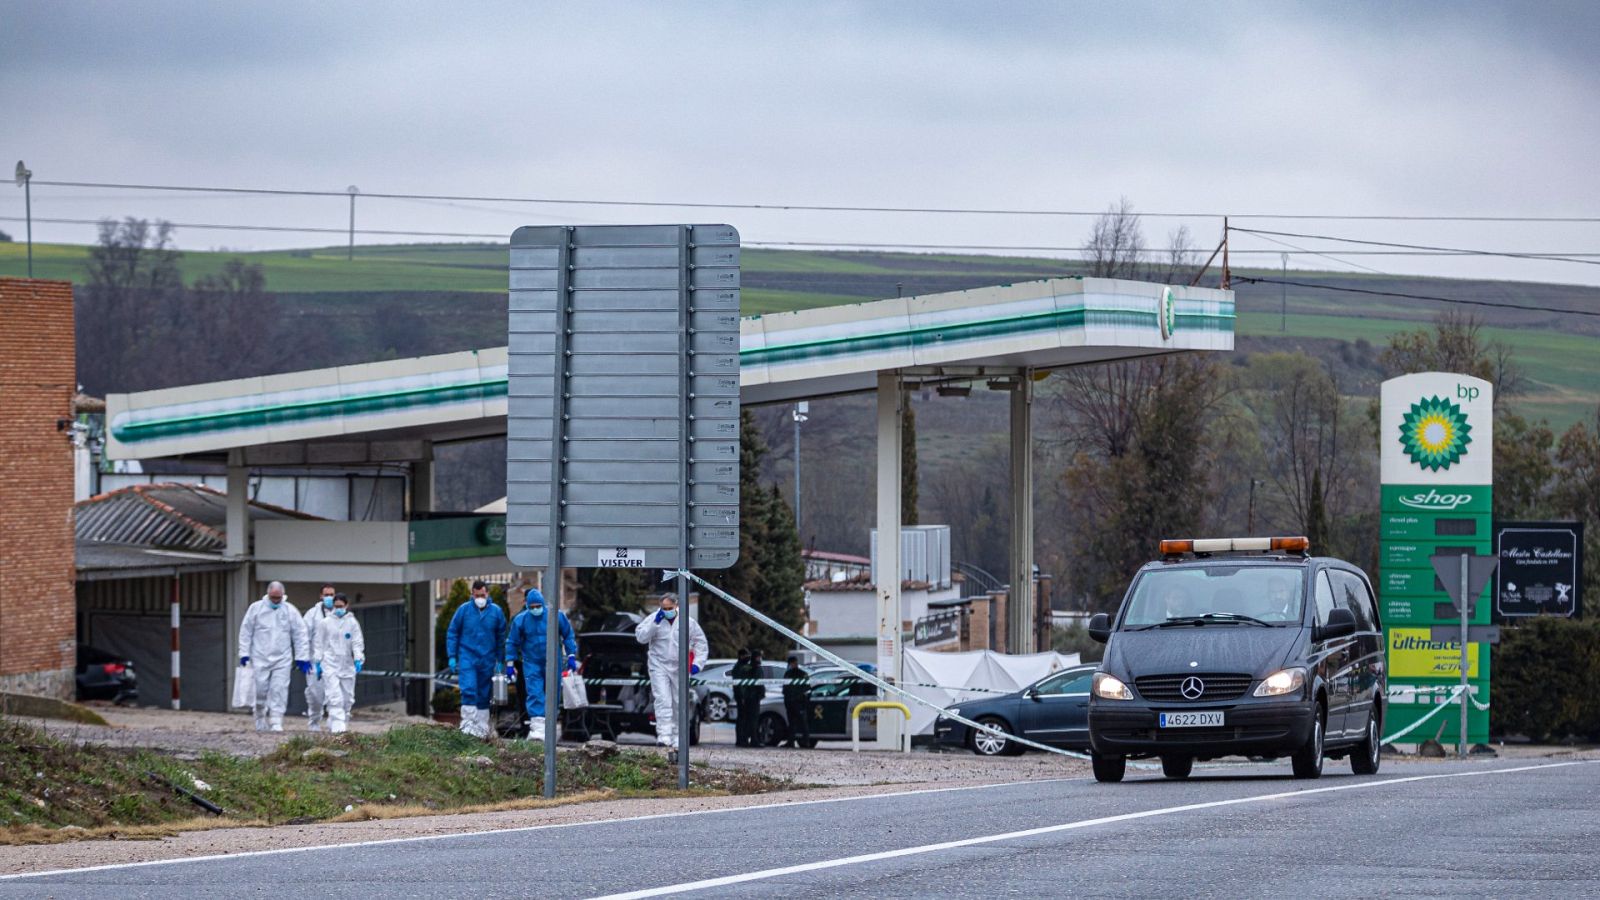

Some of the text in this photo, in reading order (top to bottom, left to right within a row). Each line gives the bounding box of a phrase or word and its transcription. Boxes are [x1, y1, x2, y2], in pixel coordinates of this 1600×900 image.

[1457, 384, 1479, 402] bp
[1409, 489, 1473, 510] shop
[1533, 546, 1572, 558] Castellano
[601, 559, 643, 567] VISEVER
[1393, 637, 1461, 650] ultimate
[1167, 714, 1222, 726] 4622 DXV
